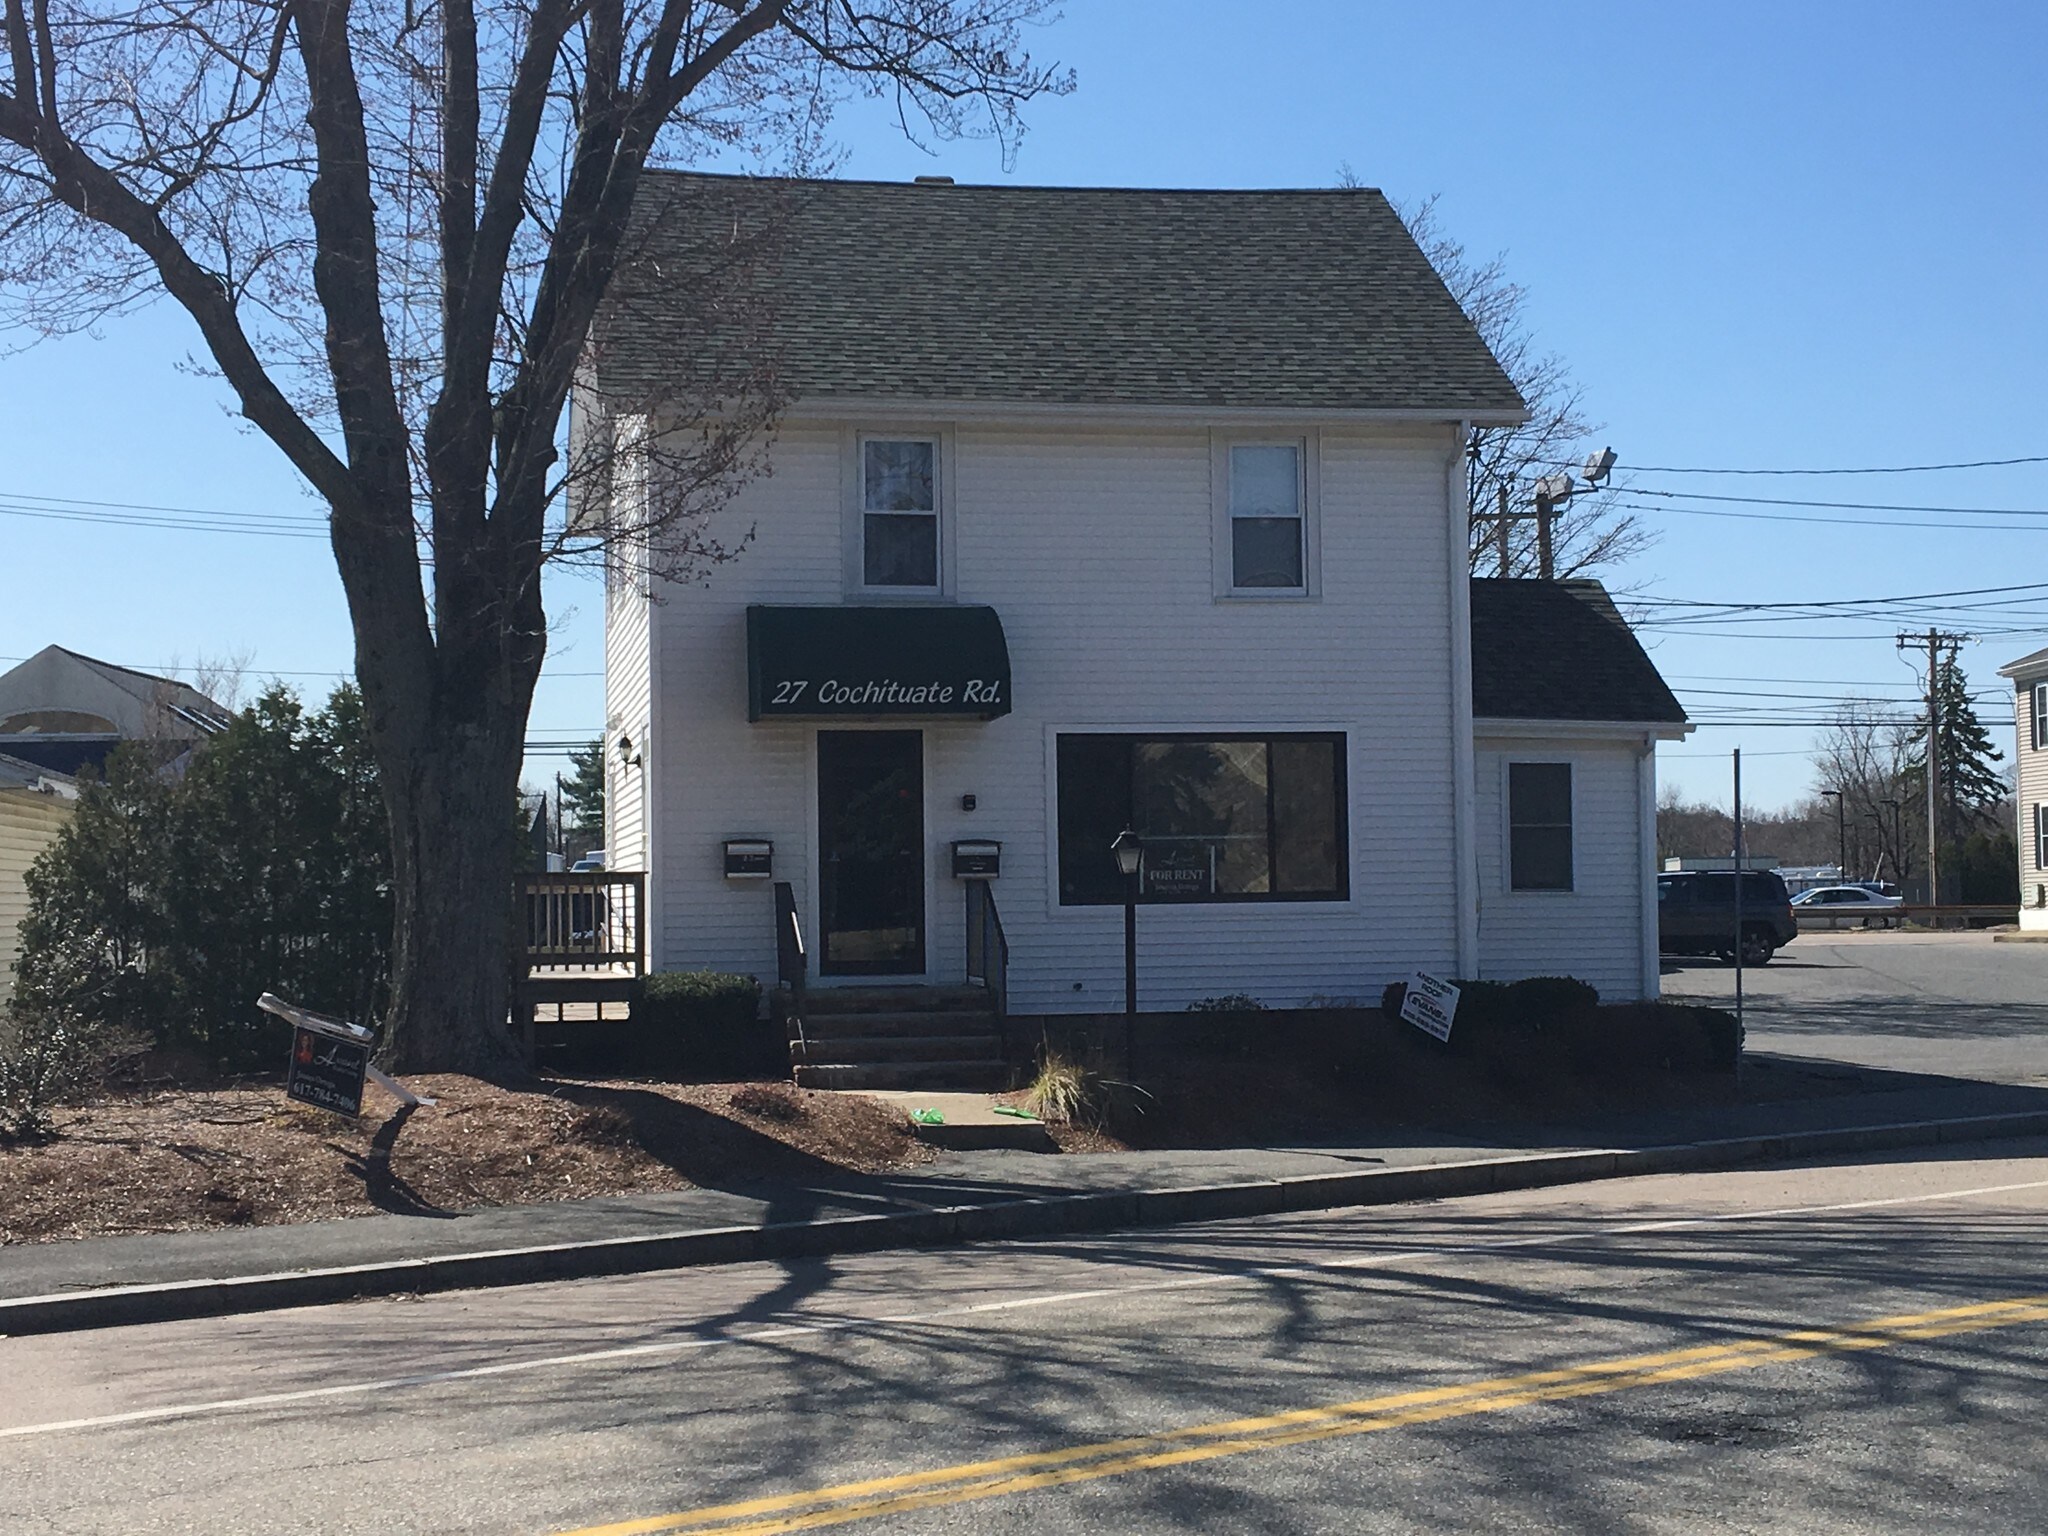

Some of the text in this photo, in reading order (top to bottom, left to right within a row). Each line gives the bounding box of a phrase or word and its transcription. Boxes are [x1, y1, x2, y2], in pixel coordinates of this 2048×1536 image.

[771, 679, 1001, 704] 27 Cochituate Rd.
[1150, 870, 1205, 880] FOR RENT
[1416, 971, 1453, 995] ANOTHER
[1411, 996, 1443, 1018] EVANS
